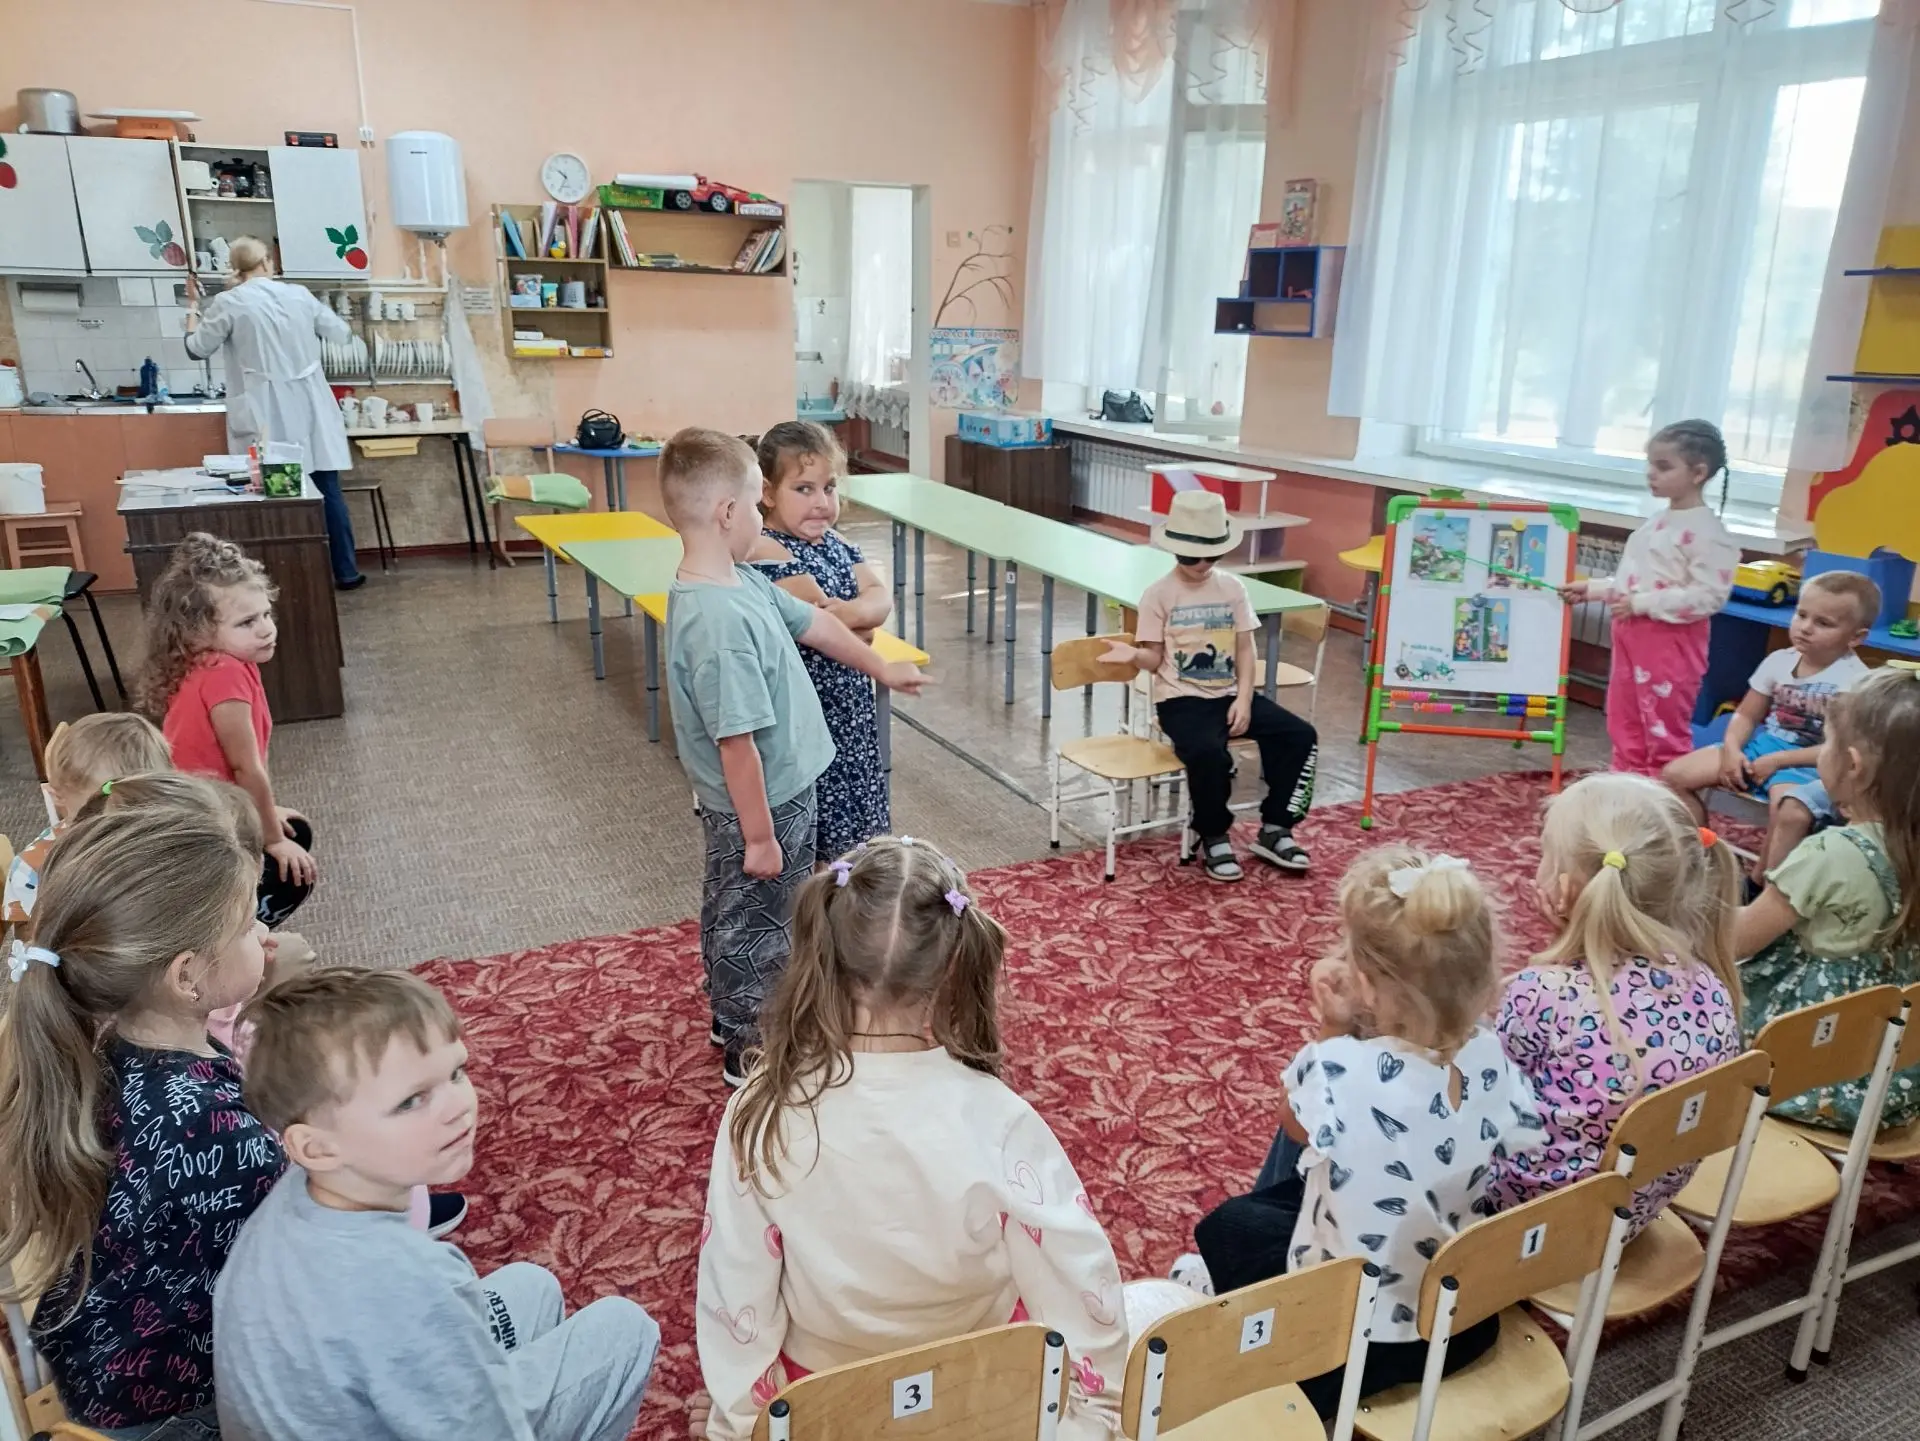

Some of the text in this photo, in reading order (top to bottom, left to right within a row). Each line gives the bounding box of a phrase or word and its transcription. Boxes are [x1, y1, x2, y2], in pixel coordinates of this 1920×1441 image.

[1819, 1021, 1831, 1041] 3
[1685, 1101, 1698, 1122] 3
[168, 1143, 224, 1190] GOOD
[1528, 1229, 1540, 1254] 1
[1249, 1320, 1264, 1345] 3
[903, 1384, 922, 1410] 3
